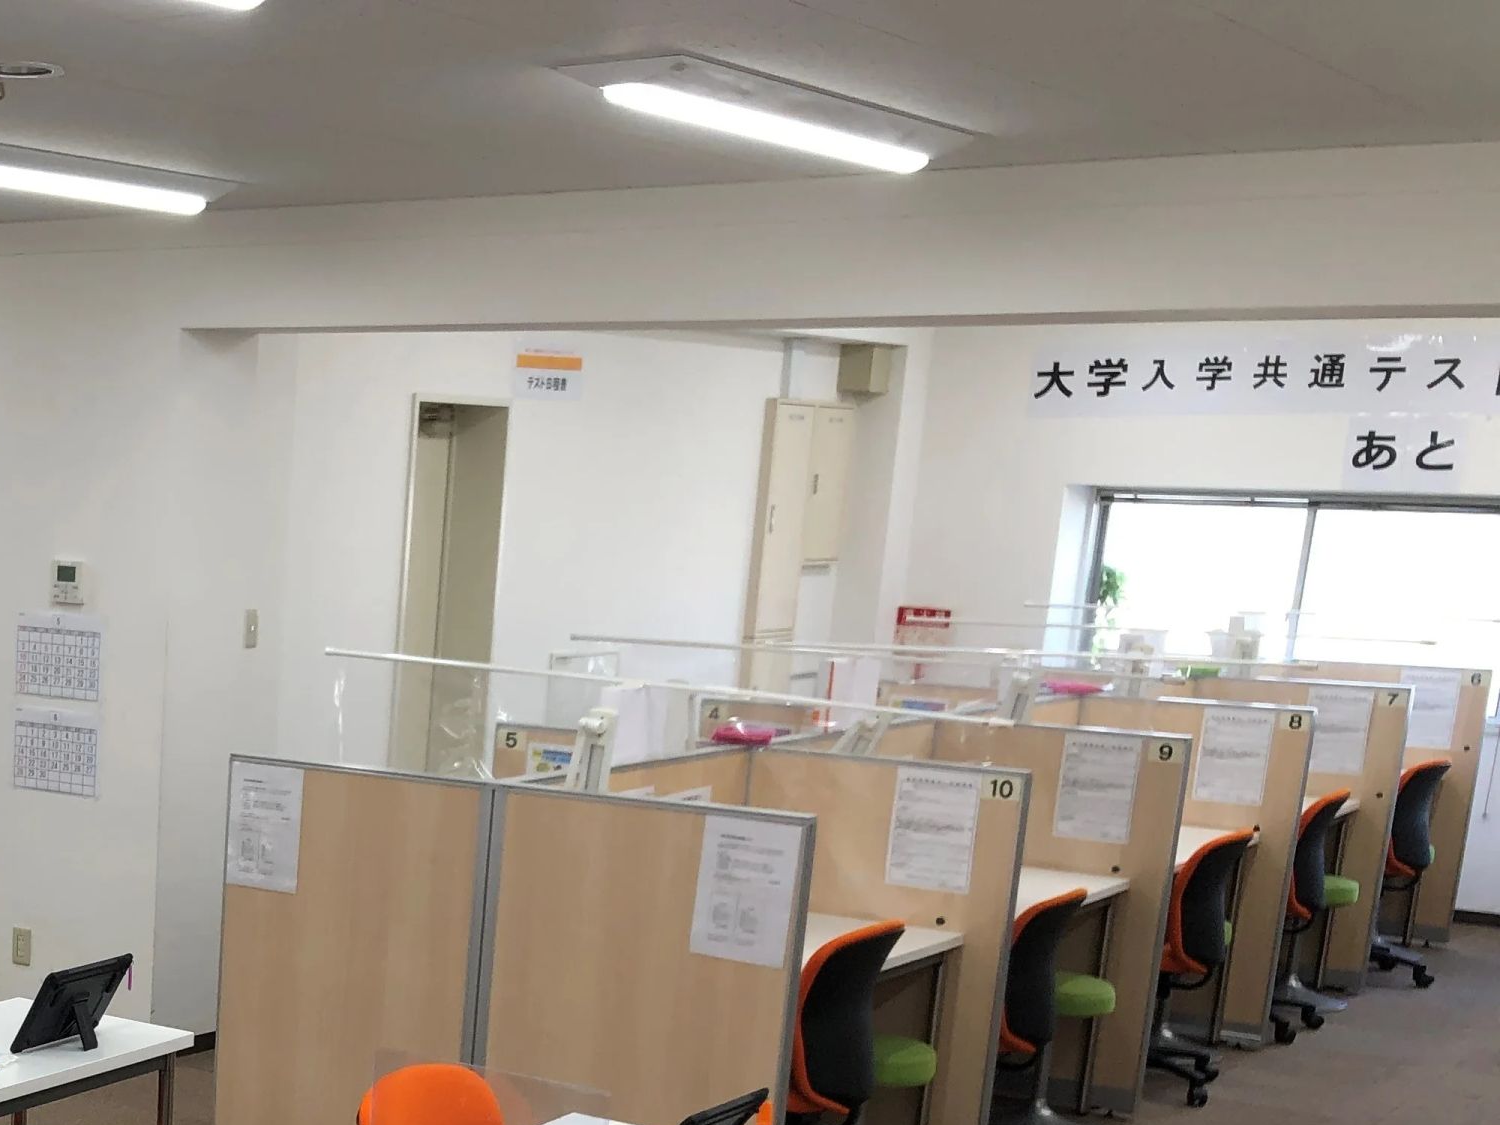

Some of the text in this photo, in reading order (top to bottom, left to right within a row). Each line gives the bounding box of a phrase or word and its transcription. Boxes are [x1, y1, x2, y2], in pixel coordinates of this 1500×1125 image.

[1033, 353, 1500, 399] 大学入学共通テス
[1351, 429, 1455, 470] あと
[1470, 672, 1482, 686] 6
[1386, 693, 1399, 707] 7
[707, 706, 720, 720] 4
[1288, 713, 1303, 731] 8
[504, 731, 518, 749] 5
[1158, 743, 1174, 762] 9
[990, 778, 1014, 799] 10
